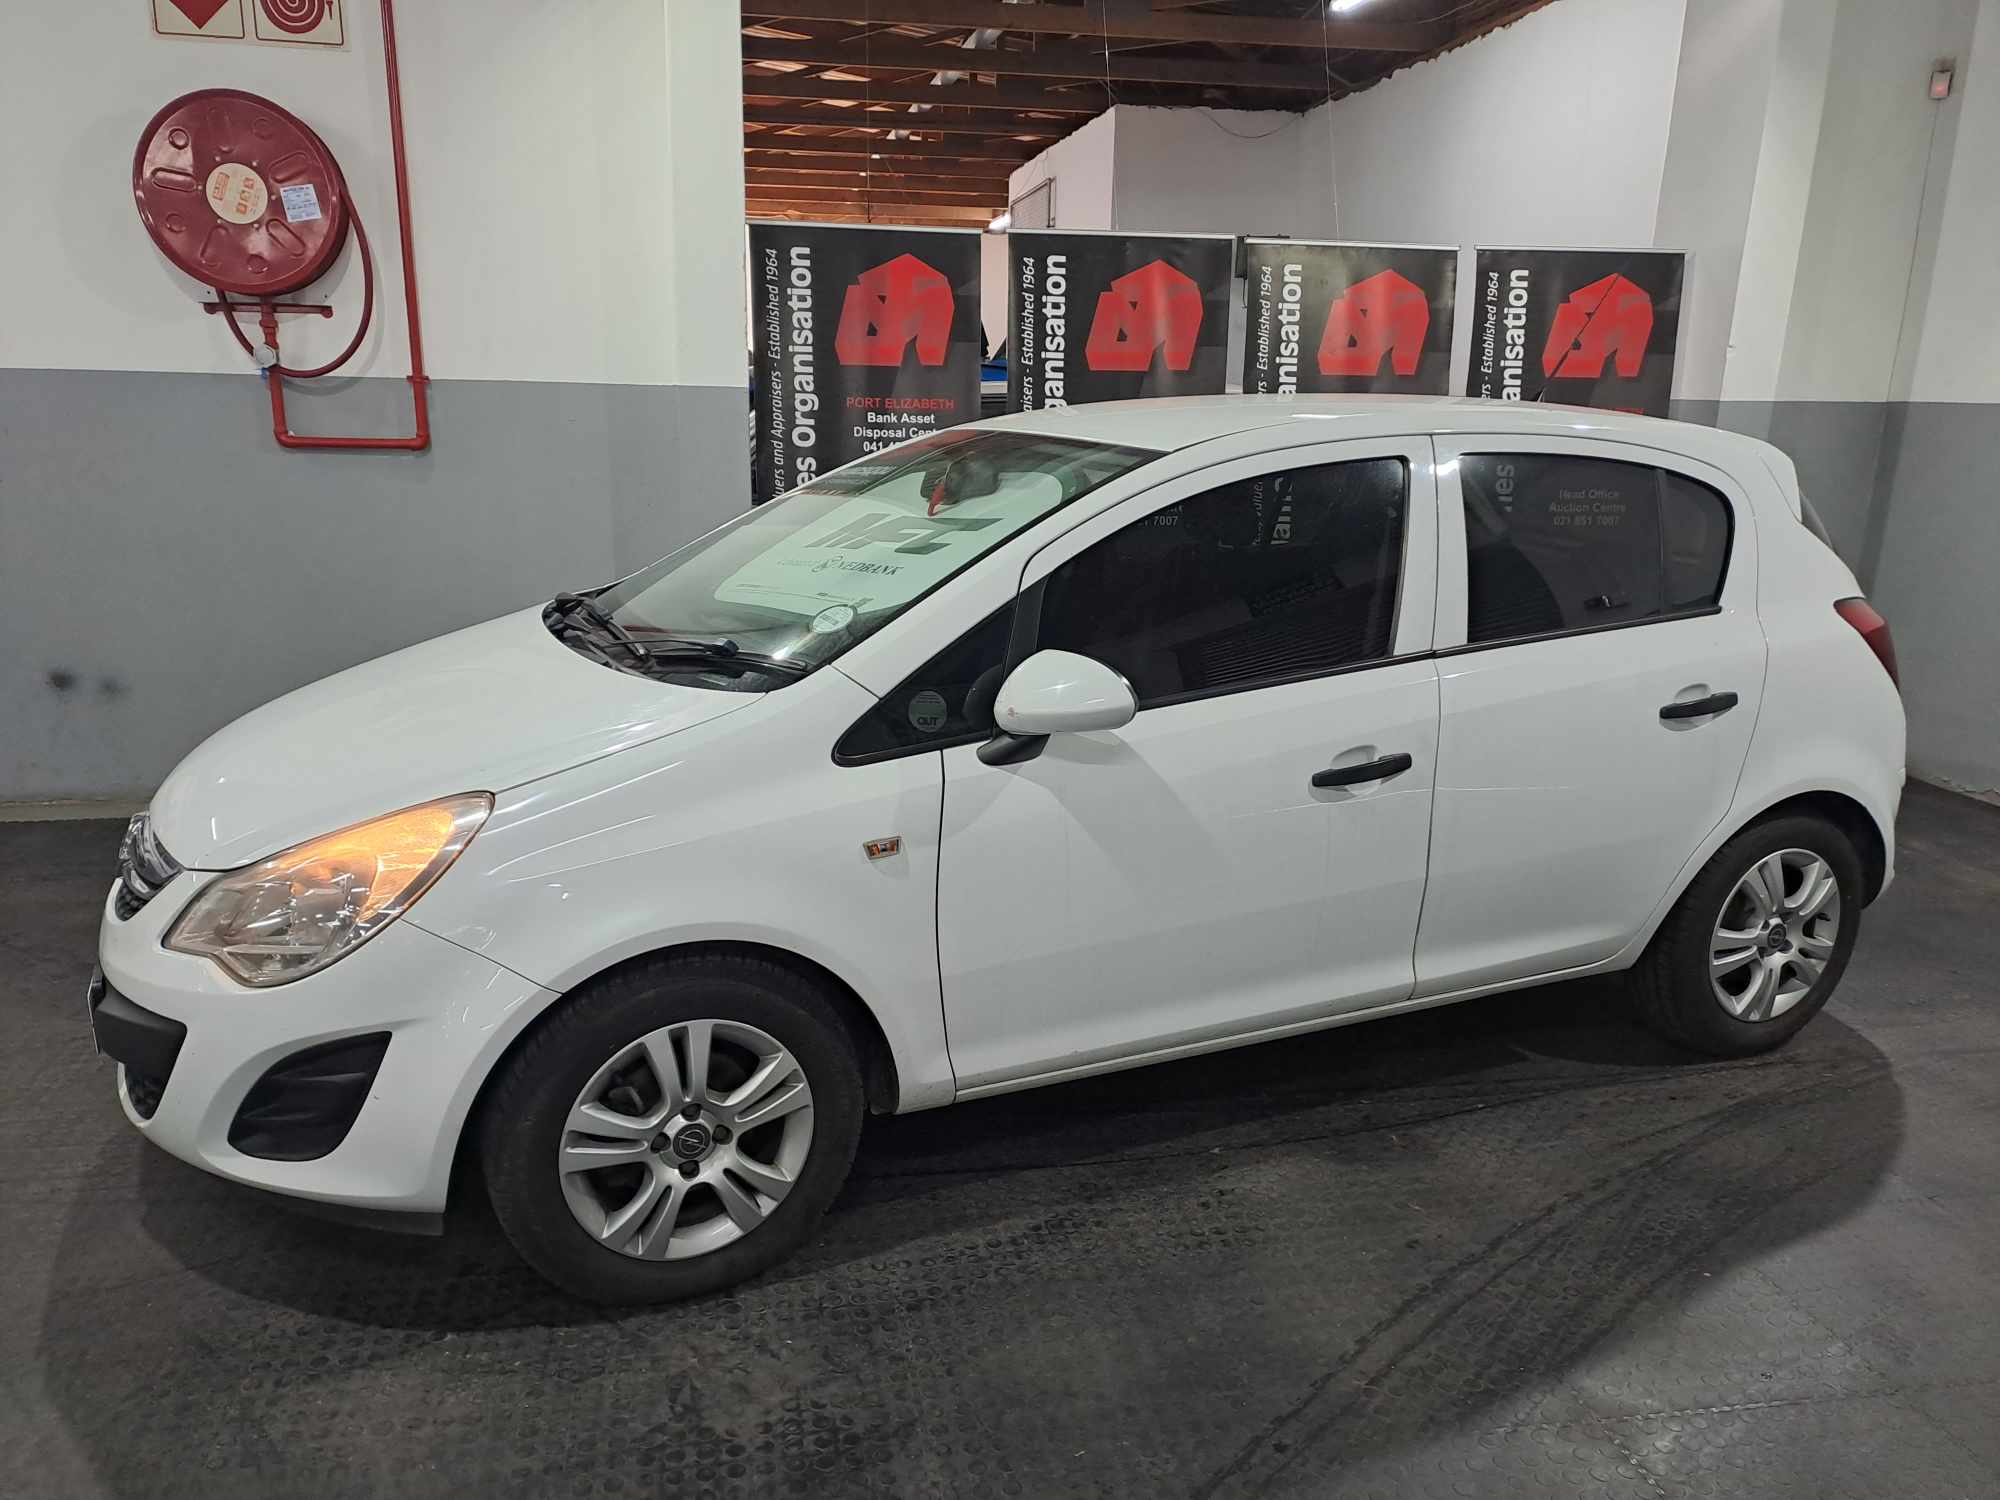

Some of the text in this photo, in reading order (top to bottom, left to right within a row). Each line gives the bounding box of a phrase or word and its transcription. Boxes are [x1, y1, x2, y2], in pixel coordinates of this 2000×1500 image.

[765, 248, 779, 281] 1964
[1022, 257, 1036, 289] 1964
[1260, 265, 1273, 296] 1964
[1486, 271, 1500, 302] 1964
[765, 284, 781, 360] Established
[1021, 292, 1035, 366] Established
[1256, 299, 1271, 371] Established
[1480, 304, 1498, 374] Established
[769, 370, 786, 438] Appraisers
[846, 397, 955, 410] PORT ELIZABETH
[867, 411, 936, 425] Bank Asset
[853, 426, 906, 440] Disposal
[863, 441, 883, 452] 041
[770, 440, 785, 465] and
